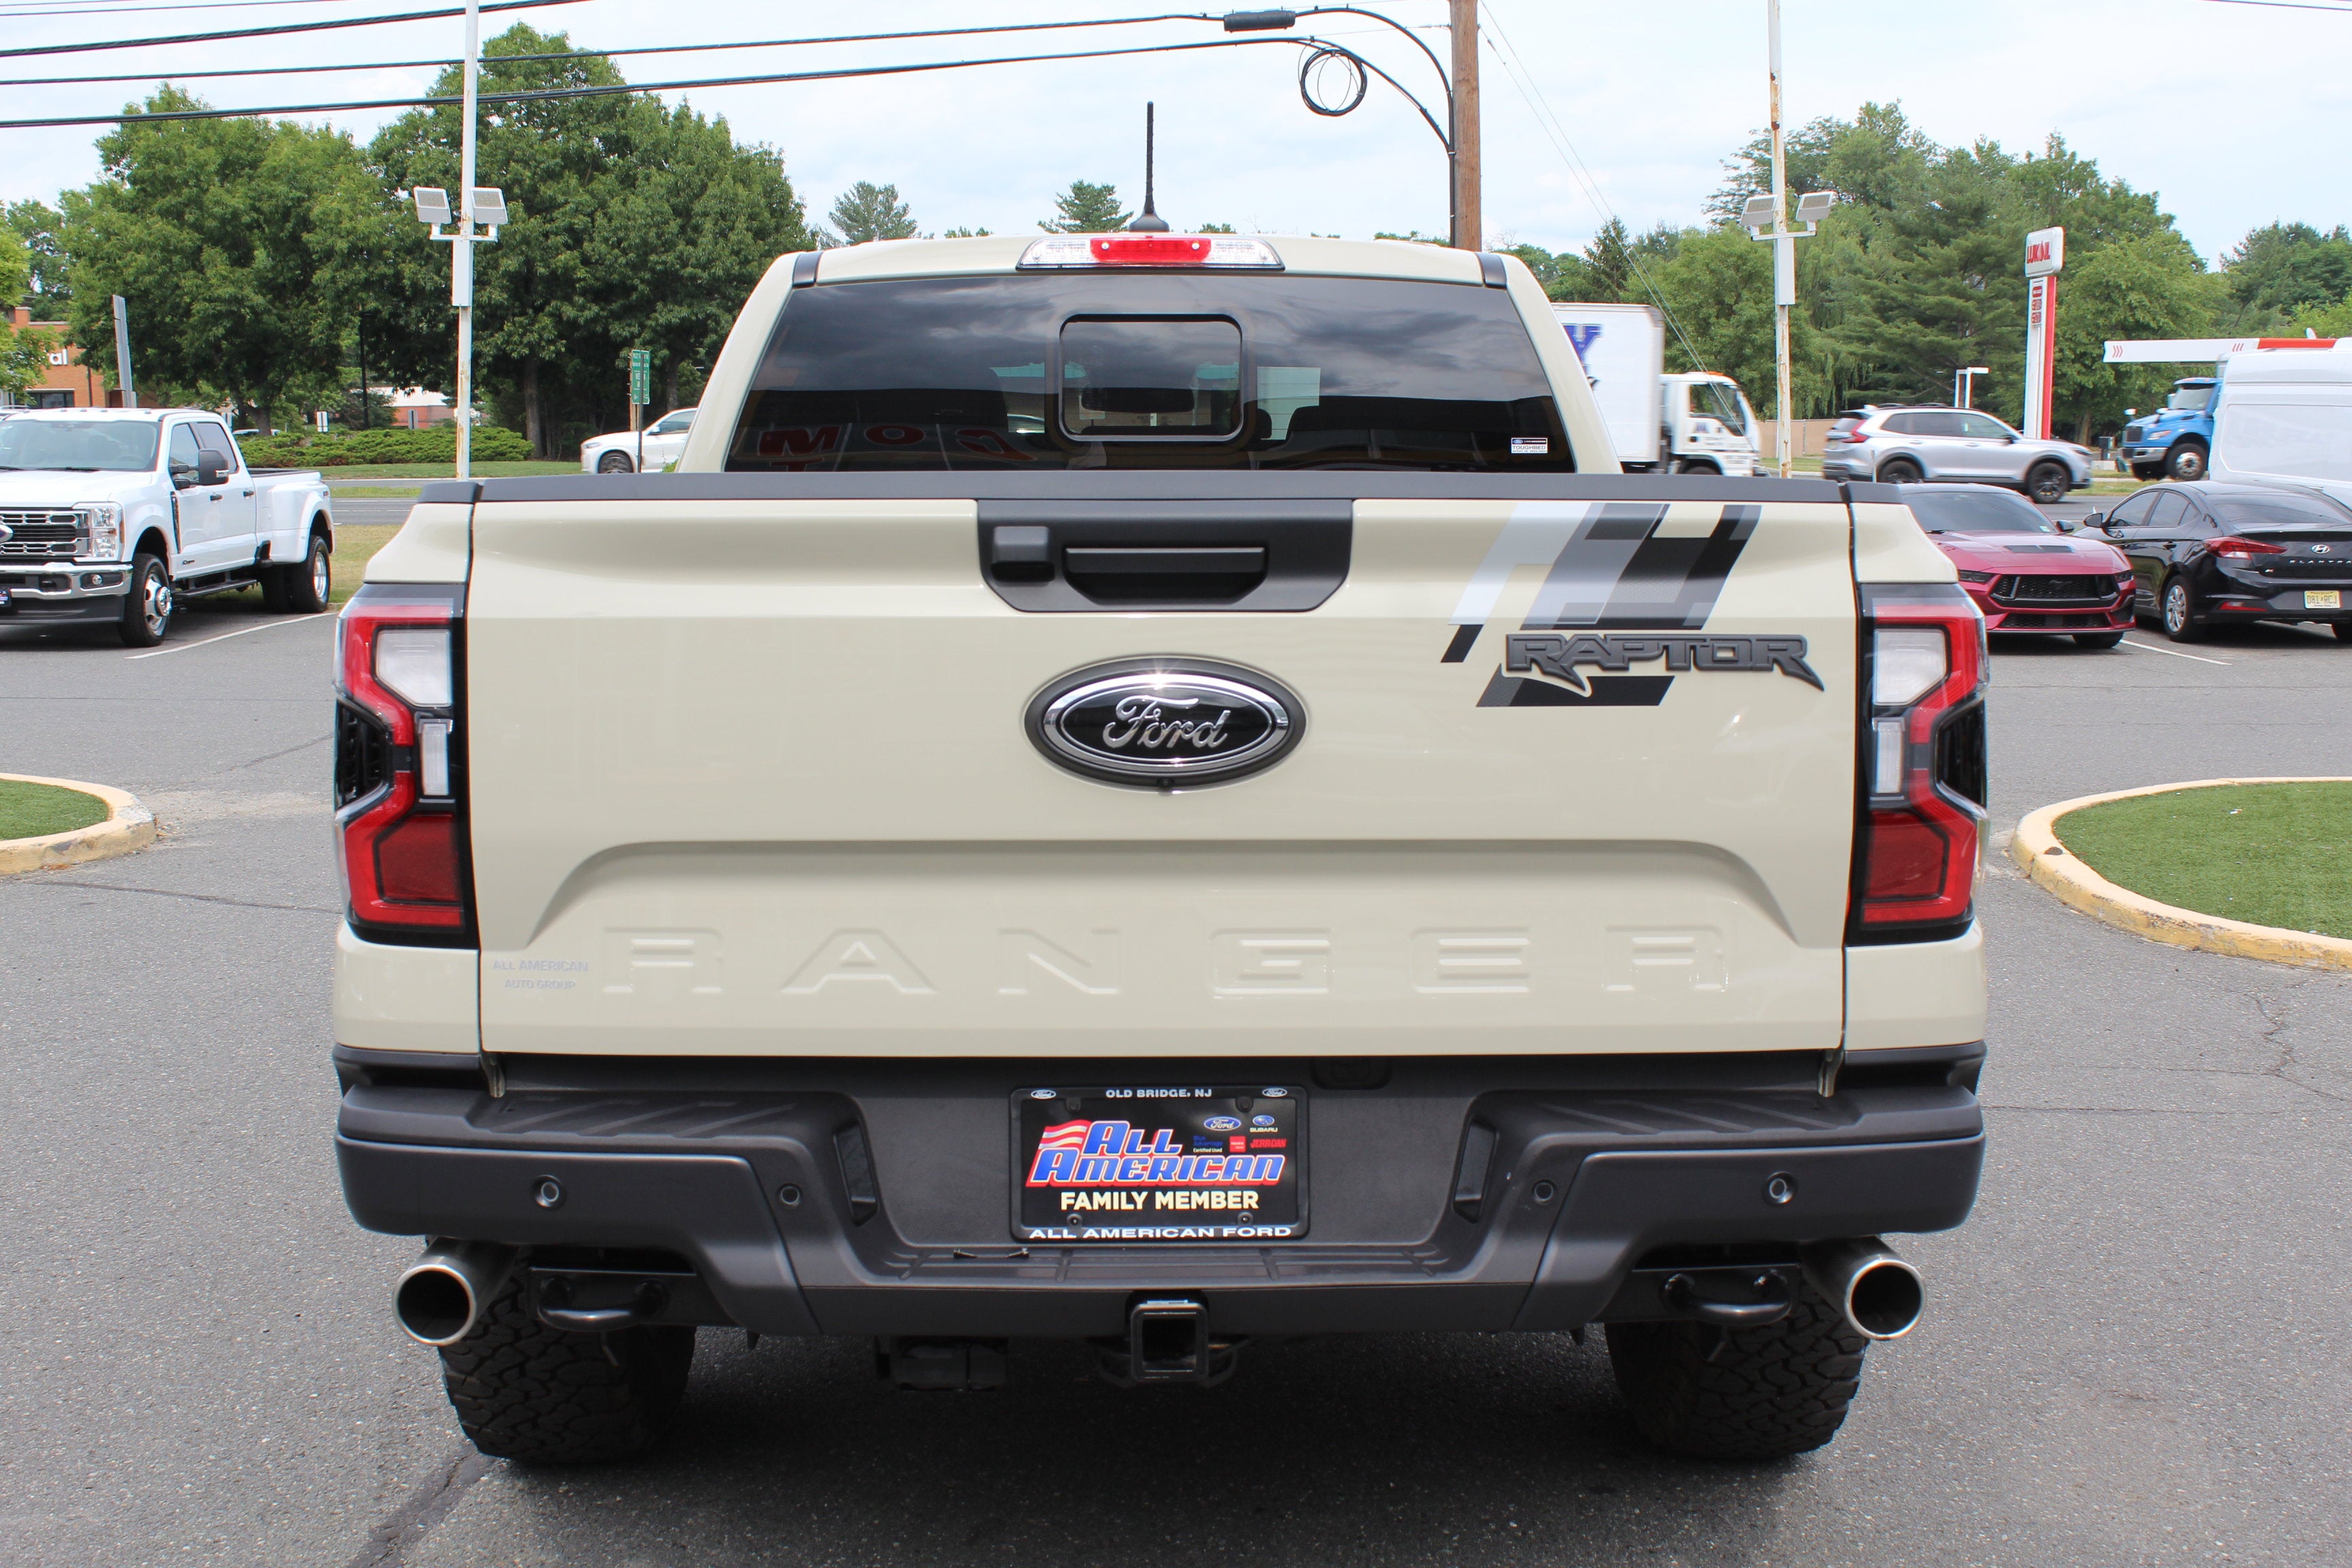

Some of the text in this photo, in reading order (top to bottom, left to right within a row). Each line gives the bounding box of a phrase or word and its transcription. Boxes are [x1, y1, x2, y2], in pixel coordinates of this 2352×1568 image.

[1505, 633, 1825, 691] RAPTOR
[1102, 695, 1230, 749] Ford
[493, 960, 589, 972] ALL AMERICAN
[602, 926, 1729, 996] RANGER
[505, 979, 576, 990] AUTO GROUP
[1105, 1089, 1212, 1098] OLD BRIDGE, NJ
[1210, 1118, 1235, 1129] Ford
[1060, 1190, 1259, 1211] FAMILY MEMBER
[1029, 1227, 1292, 1239] ALL AMERICAN FORD
